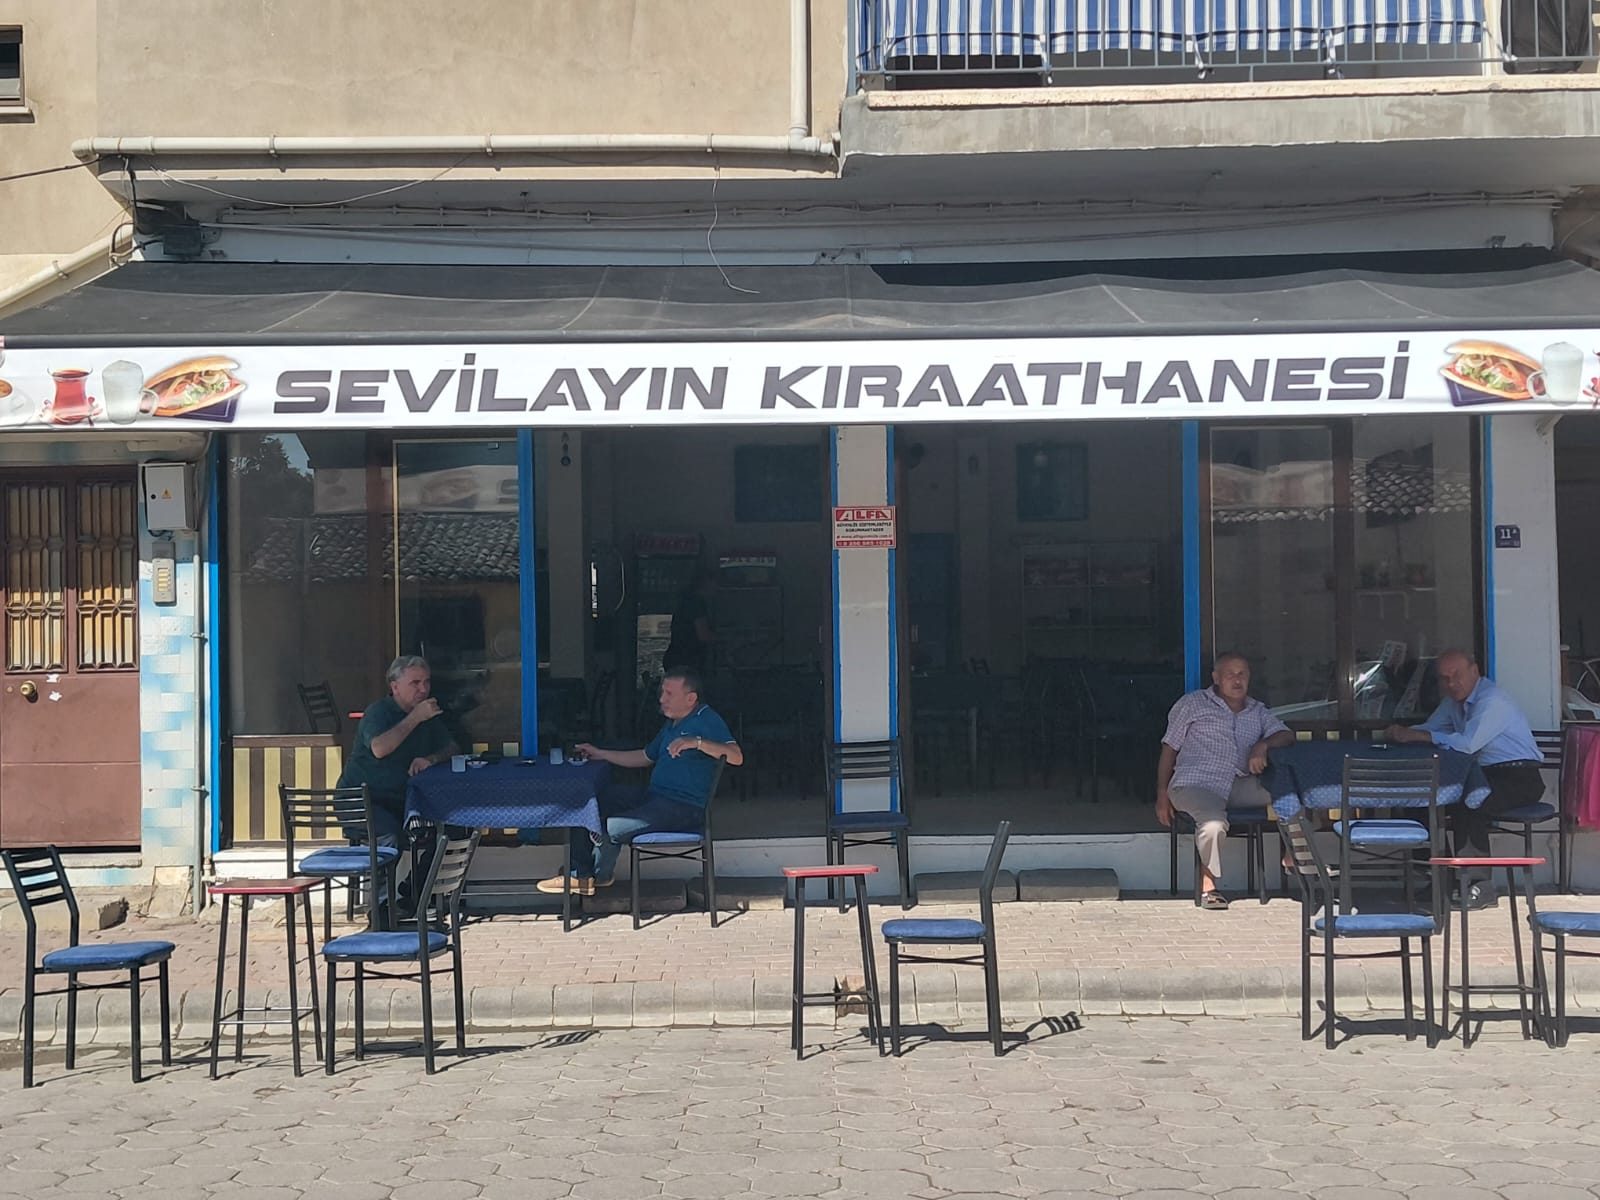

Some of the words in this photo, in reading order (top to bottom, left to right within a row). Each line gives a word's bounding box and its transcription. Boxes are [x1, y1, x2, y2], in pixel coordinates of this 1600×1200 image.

[273, 352, 729, 414] SEVİLAYIN
[759, 339, 1410, 410] KIRAATHANESİ
[839, 509, 889, 520] ALFA
